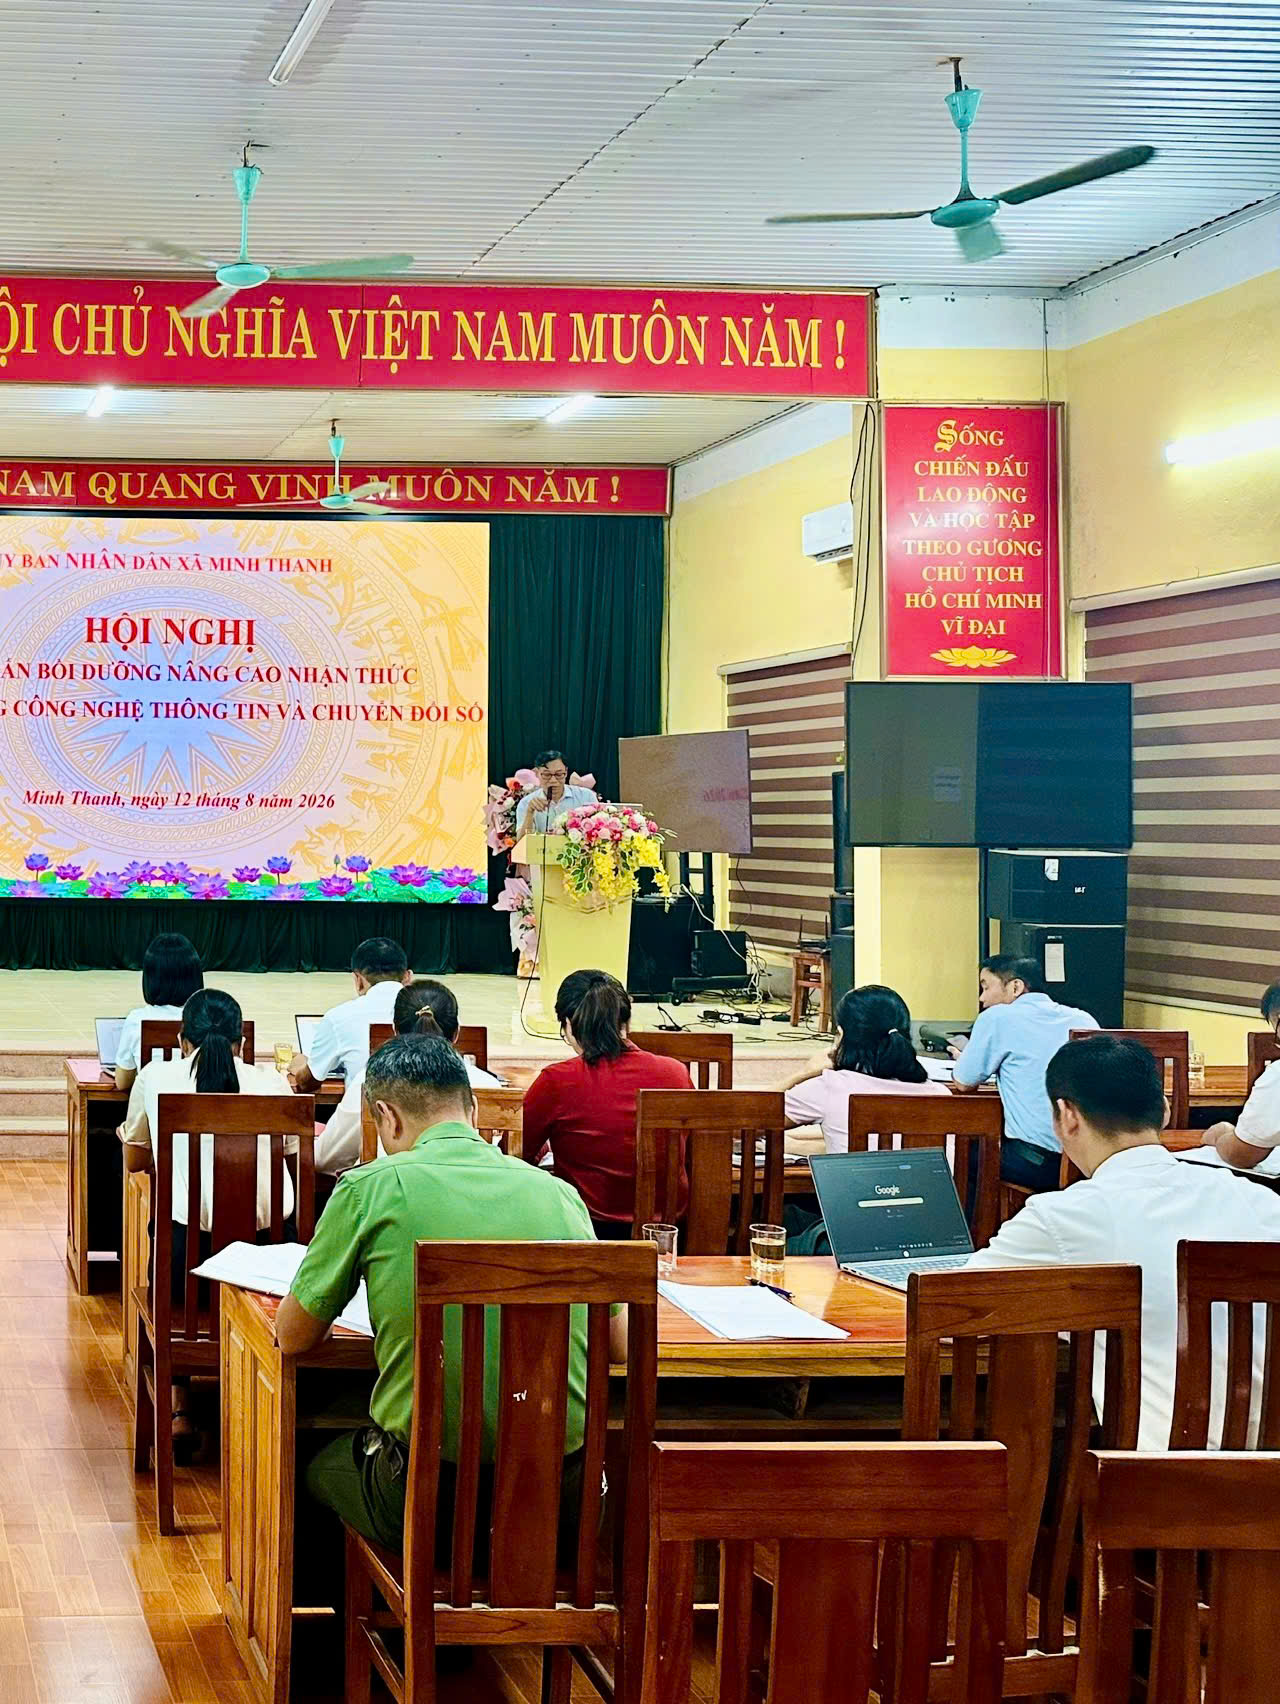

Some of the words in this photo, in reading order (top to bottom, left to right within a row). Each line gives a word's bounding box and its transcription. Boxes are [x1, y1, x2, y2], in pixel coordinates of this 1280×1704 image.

[52, 286, 151, 356] CHỦ
[164, 296, 317, 358] NGHĨA
[328, 294, 440, 374] VIỆT
[453, 311, 556, 363] NAM
[570, 299, 707, 365] MUÔN
[721, 306, 821, 368] NĂM
[934, 420, 1005, 453] SỐNG
[914, 455, 980, 477] CHIẾN
[985, 454, 1029, 477] ĐẤU
[88, 471, 236, 506] QUANG
[247, 474, 354, 500] VINH
[366, 468, 493, 502] MUÔN
[504, 469, 598, 503] NĂM
[917, 487, 961, 502] LAO
[967, 482, 1027, 504] ĐỘNG
[909, 507, 937, 528] VÀ
[943, 512, 989, 533] HỌC
[995, 509, 1036, 532] TẬP
[903, 539, 962, 556] THEO
[967, 538, 1042, 557] GƯƠNG
[22, 554, 59, 569] BAN
[66, 548, 126, 570] NHÂN
[133, 551, 172, 571] DÂN
[177, 553, 203, 571] XÃ
[209, 557, 261, 572] MINH
[265, 558, 333, 573] THANH
[922, 561, 968, 583] CHỦ
[973, 567, 1024, 586] TỊCH
[905, 588, 937, 609] HỒ
[942, 590, 981, 609] CHÍ
[986, 593, 1042, 609] MINH
[84, 612, 151, 651] HỘI
[163, 618, 257, 653] NGHỊ
[941, 615, 965, 635] VĨ
[968, 619, 1006, 638] ĐẠI
[81, 659, 162, 682] DƯỠNG
[167, 660, 229, 683] NÂNG
[235, 665, 282, 684] CAO
[288, 664, 350, 688] NHẬN
[355, 664, 418, 685] THỨC
[13, 694, 76, 718] CÔNG
[82, 698, 144, 722] NGHỆ
[149, 697, 228, 720] THÔNG
[233, 703, 272, 719] TIN
[276, 700, 307, 721] VÀ
[456, 700, 484, 723] SỐ
[22, 790, 65, 805] Minh
[71, 790, 125, 807] Thanh,
[130, 791, 169, 810] ngày
[174, 791, 192, 807] 12
[195, 792, 240, 811] tháng
[245, 792, 254, 808] 8
[258, 794, 293, 808] năm
[298, 794, 335, 809] 2026
[875, 1185, 900, 1196] Google
[513, 1390, 528, 1402] TV
